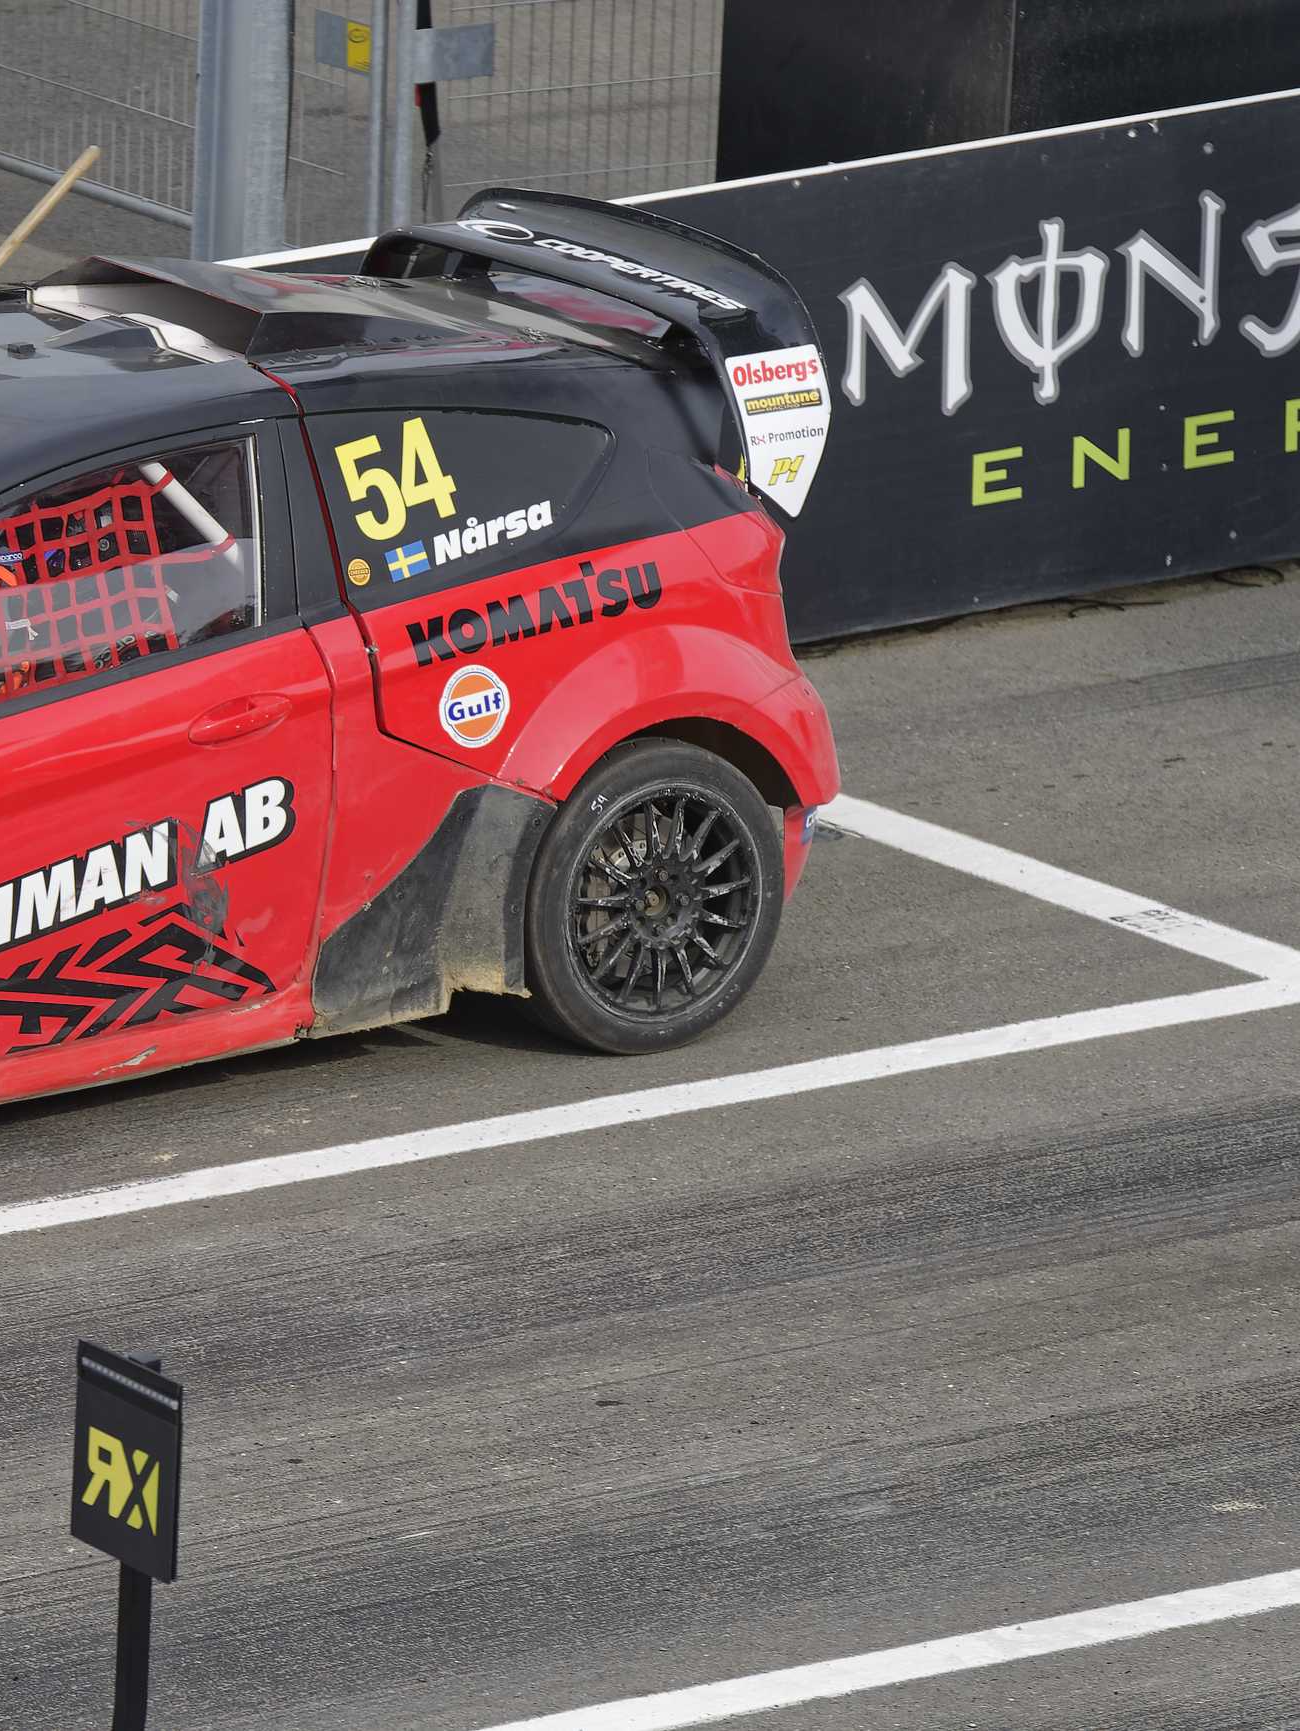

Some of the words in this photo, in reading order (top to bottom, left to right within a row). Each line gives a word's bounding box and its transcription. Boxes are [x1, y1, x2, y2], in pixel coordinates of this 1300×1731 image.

[732, 357, 819, 388] Olsbergs
[746, 389, 821, 412] mountune
[768, 426, 825, 444] Promotion
[972, 398, 1300, 507] ENE
[334, 416, 457, 541] 54
[433, 500, 554, 566] Nårsa
[405, 561, 663, 668] KOMATSU
[448, 692, 502, 721] Gulf
[197, 776, 295, 873] AB
